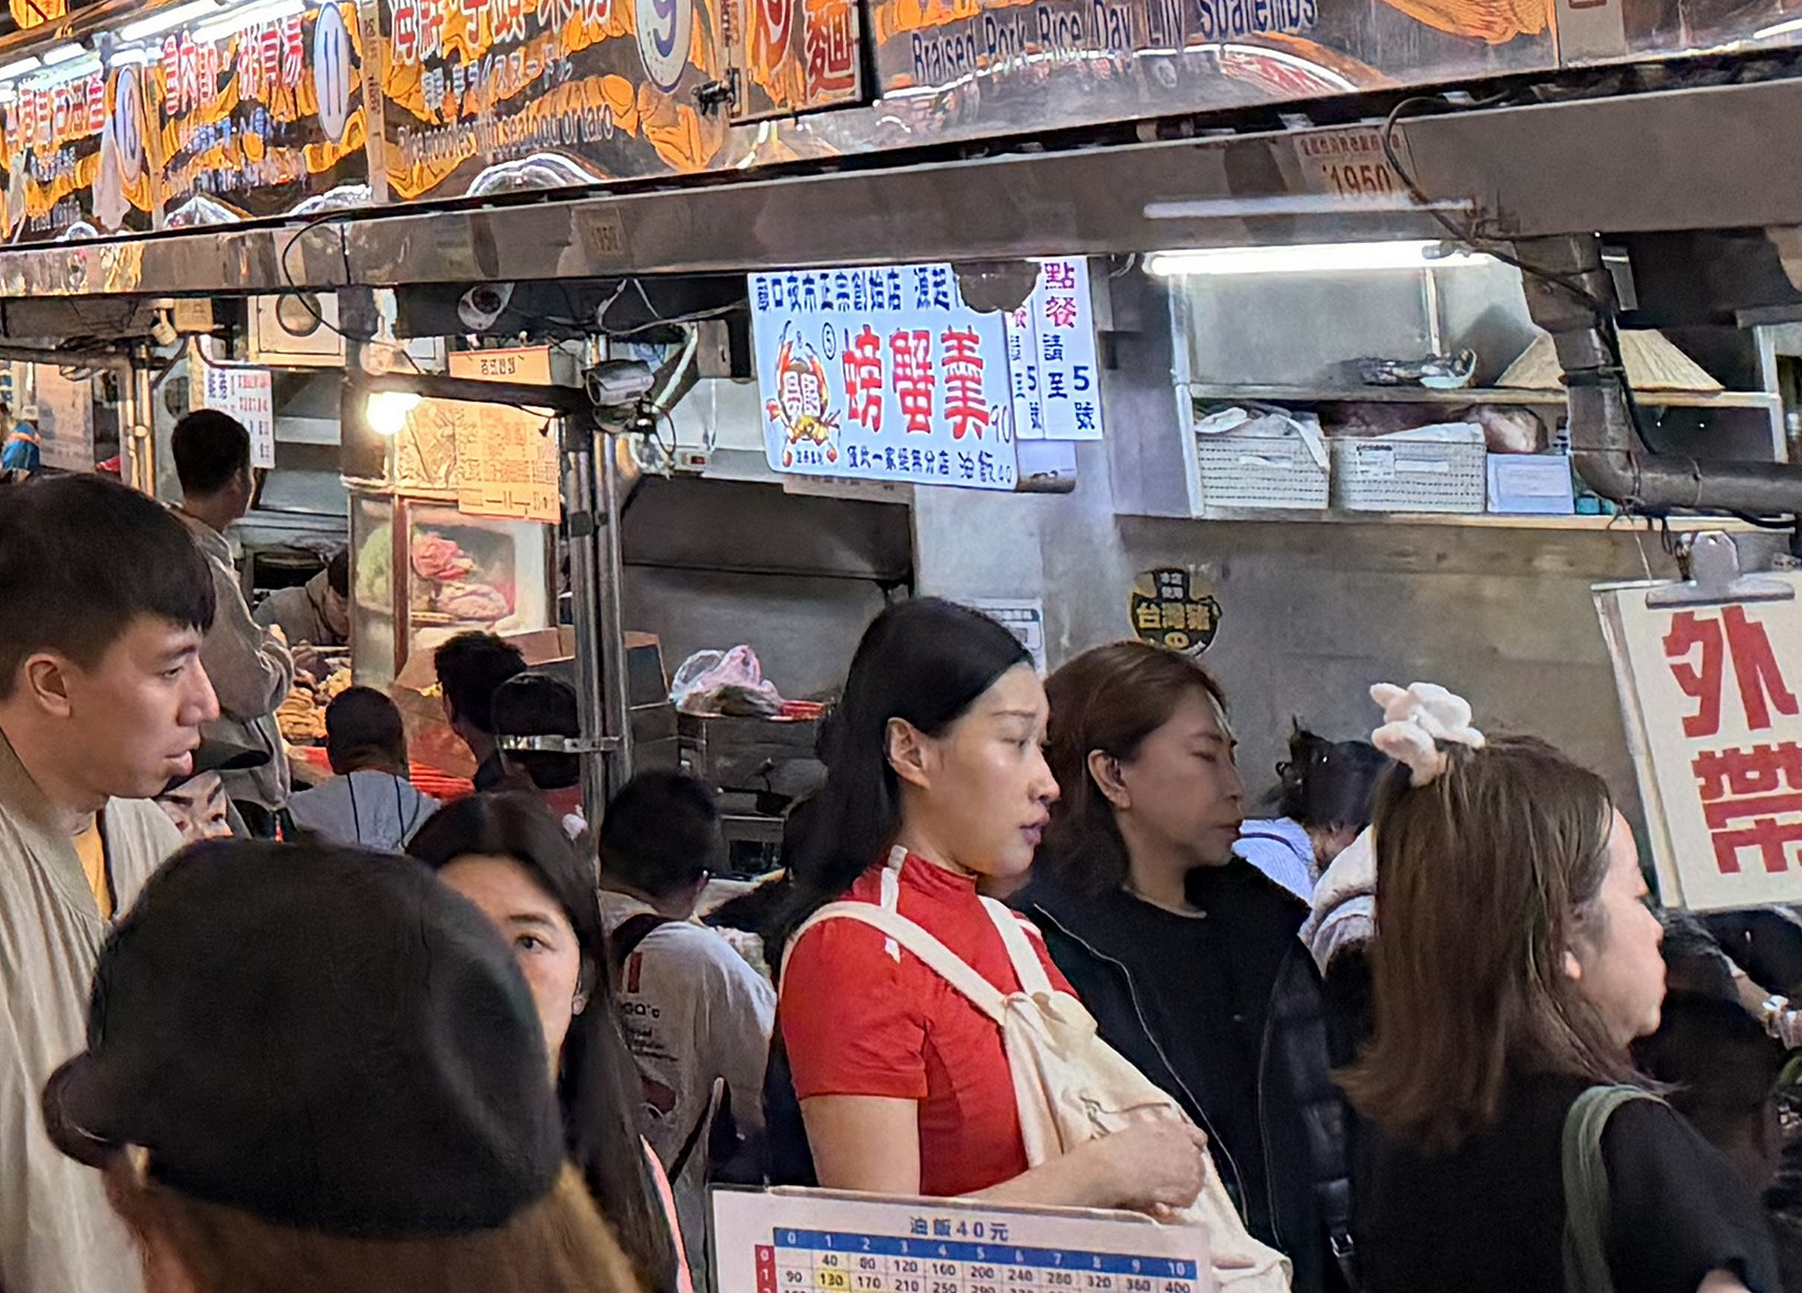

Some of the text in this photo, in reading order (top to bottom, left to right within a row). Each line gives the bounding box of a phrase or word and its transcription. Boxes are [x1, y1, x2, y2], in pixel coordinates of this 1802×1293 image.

[910, 18, 977, 83] Braised
[984, 12, 1028, 63] Pork
[1037, 3, 1083, 54] Rice
[1044, 262, 1077, 329] 點餐
[1136, 602, 1212, 632] 台灣豬
[1662, 604, 1802, 876] 外帶
[825, 1235, 833, 1248] 1
[861, 1237, 871, 1251] 2
[821, 1254, 839, 1268] 40
[893, 1259, 919, 1274] 120
[970, 1265, 995, 1280] 200
[857, 1275, 882, 1291] 170
